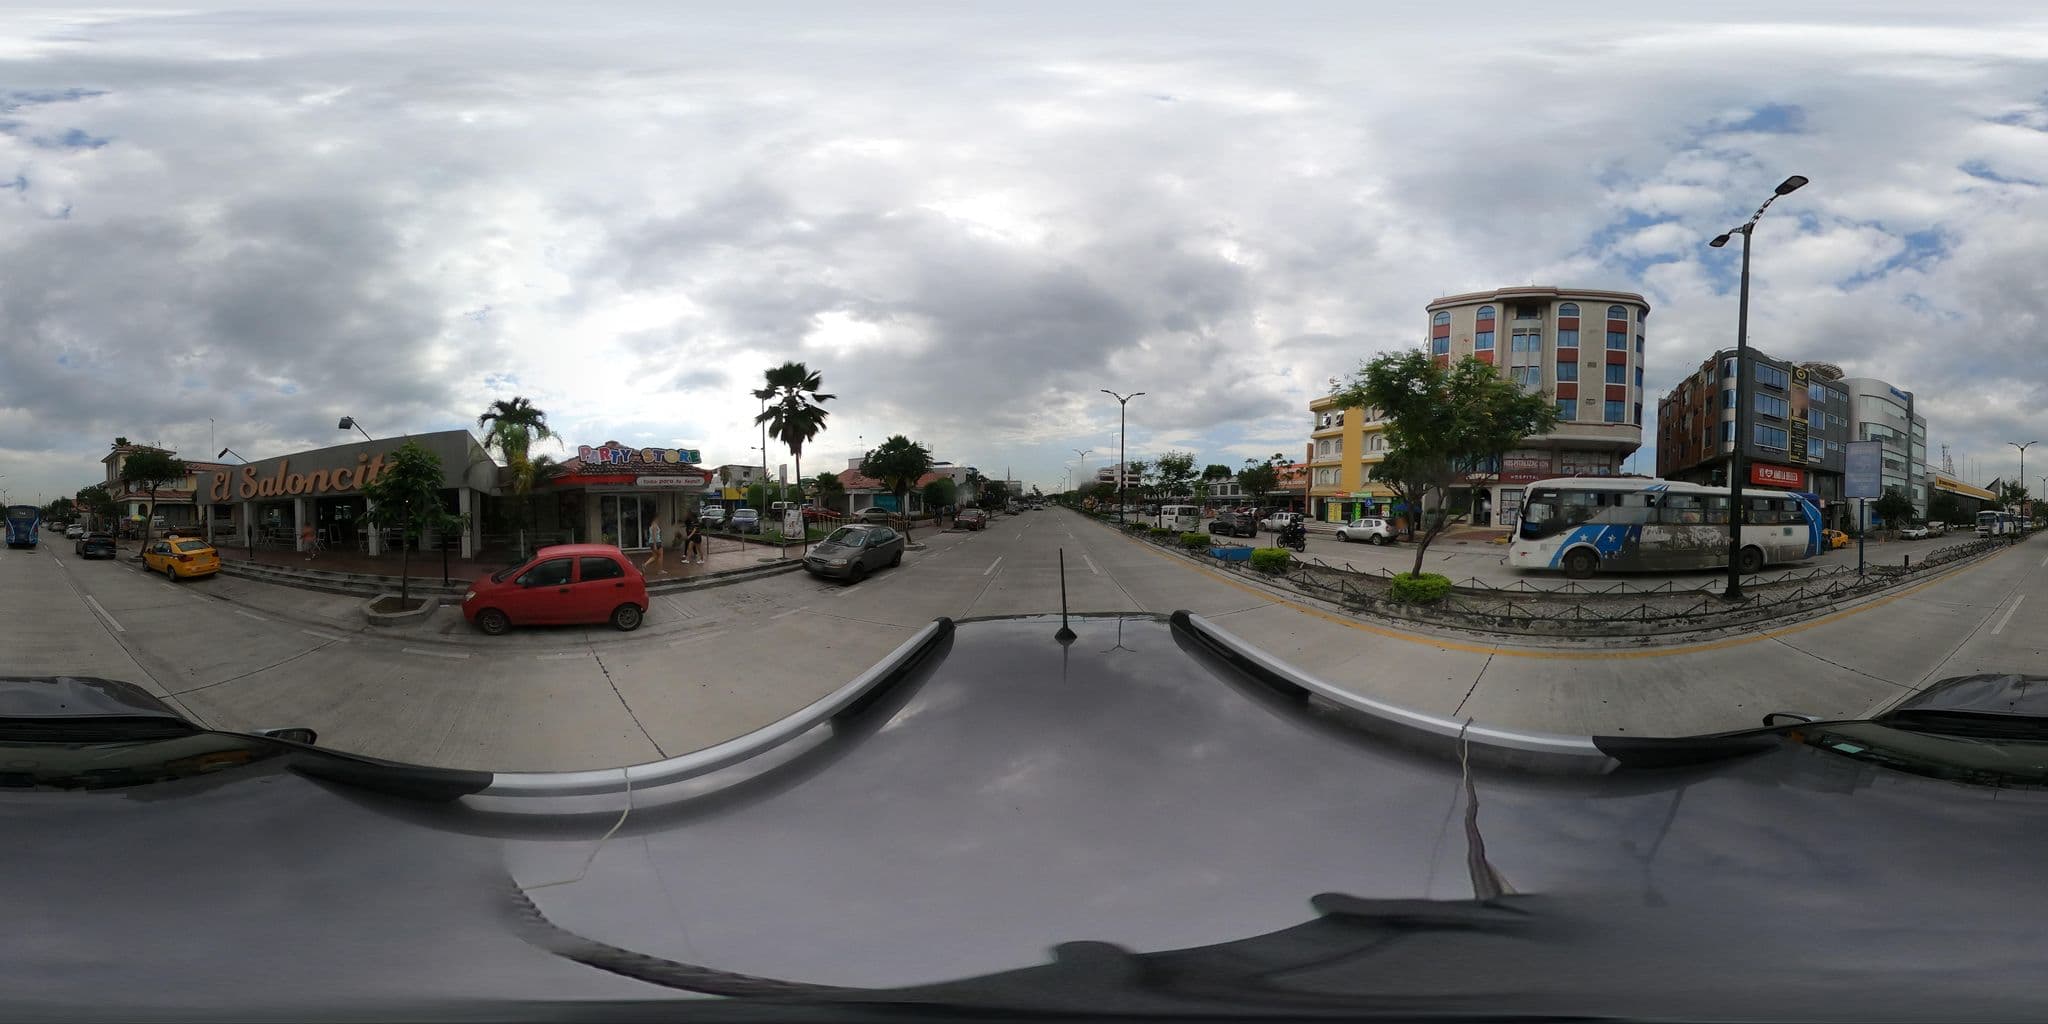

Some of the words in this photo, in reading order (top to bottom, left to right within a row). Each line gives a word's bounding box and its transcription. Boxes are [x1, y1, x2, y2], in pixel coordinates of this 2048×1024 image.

[578, 445, 632, 464] PARTY
[641, 447, 702, 464] STORE
[210, 469, 233, 502] El
